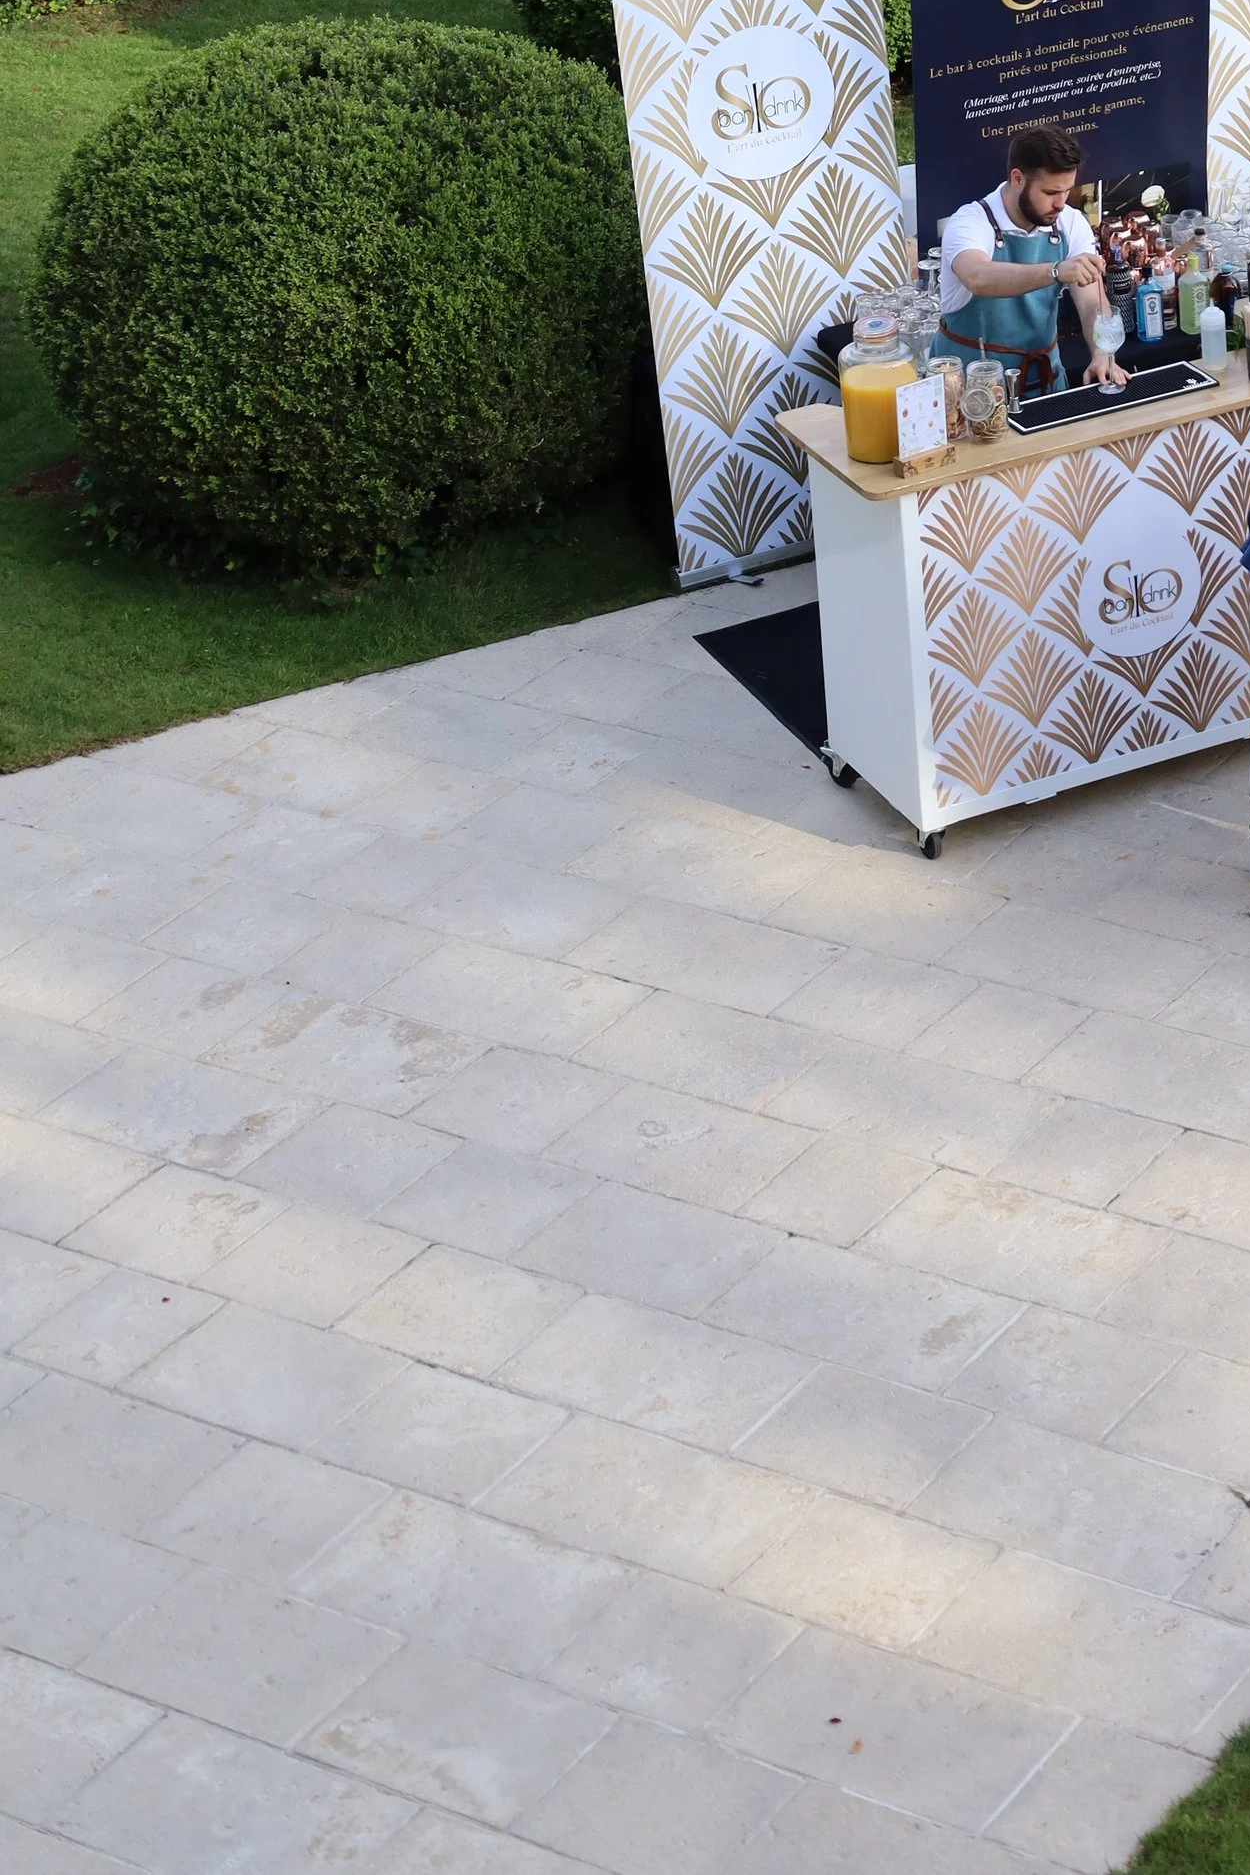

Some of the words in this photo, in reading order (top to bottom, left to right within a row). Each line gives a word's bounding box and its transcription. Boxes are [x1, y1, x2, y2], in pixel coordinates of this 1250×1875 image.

[1015, 11, 1040, 25] L'art
[1042, 7, 1057, 20] du
[929, 68, 944, 79] Le
[946, 64, 965, 75] bar
[967, 60, 974, 71] à
[976, 50, 1023, 69] cocktails
[1025, 47, 1032, 58] à
[1034, 38, 1080, 56] domicile
[1083, 33, 1109, 49] pour
[1112, 29, 1130, 40] vos
[1132, 15, 1195, 36] événements
[999, 64, 1031, 84] privés
[1033, 63, 1048, 72] ou
[1050, 45, 1128, 72] professionnels
[963, 93, 1009, 110] (Mariage,
[1011, 78, 1074, 100] anniversaire,
[1076, 72, 1105, 85] soirée
[1105, 60, 1162, 78] d'entreprise,
[965, 101, 1016, 120] lancement
[1017, 98, 1030, 108] de
[1032, 90, 1069, 103] marque
[1070, 87, 1084, 96] ou
[1086, 83, 1099, 93] de
[1099, 75, 1137, 93] produit,
[717, 107, 752, 128] bar
[763, 90, 805, 118] drink
[981, 126, 1004, 138] Une
[1007, 113, 1060, 136] prestation
[1062, 108, 1086, 120] haut
[1088, 103, 1102, 114] de
[1104, 95, 1146, 115] gamme,
[1065, 121, 1099, 134] mains.
[765, 128, 802, 145] Cocktail
[1141, 580, 1177, 604] drink
[1142, 612, 1174, 627] Cocktail
